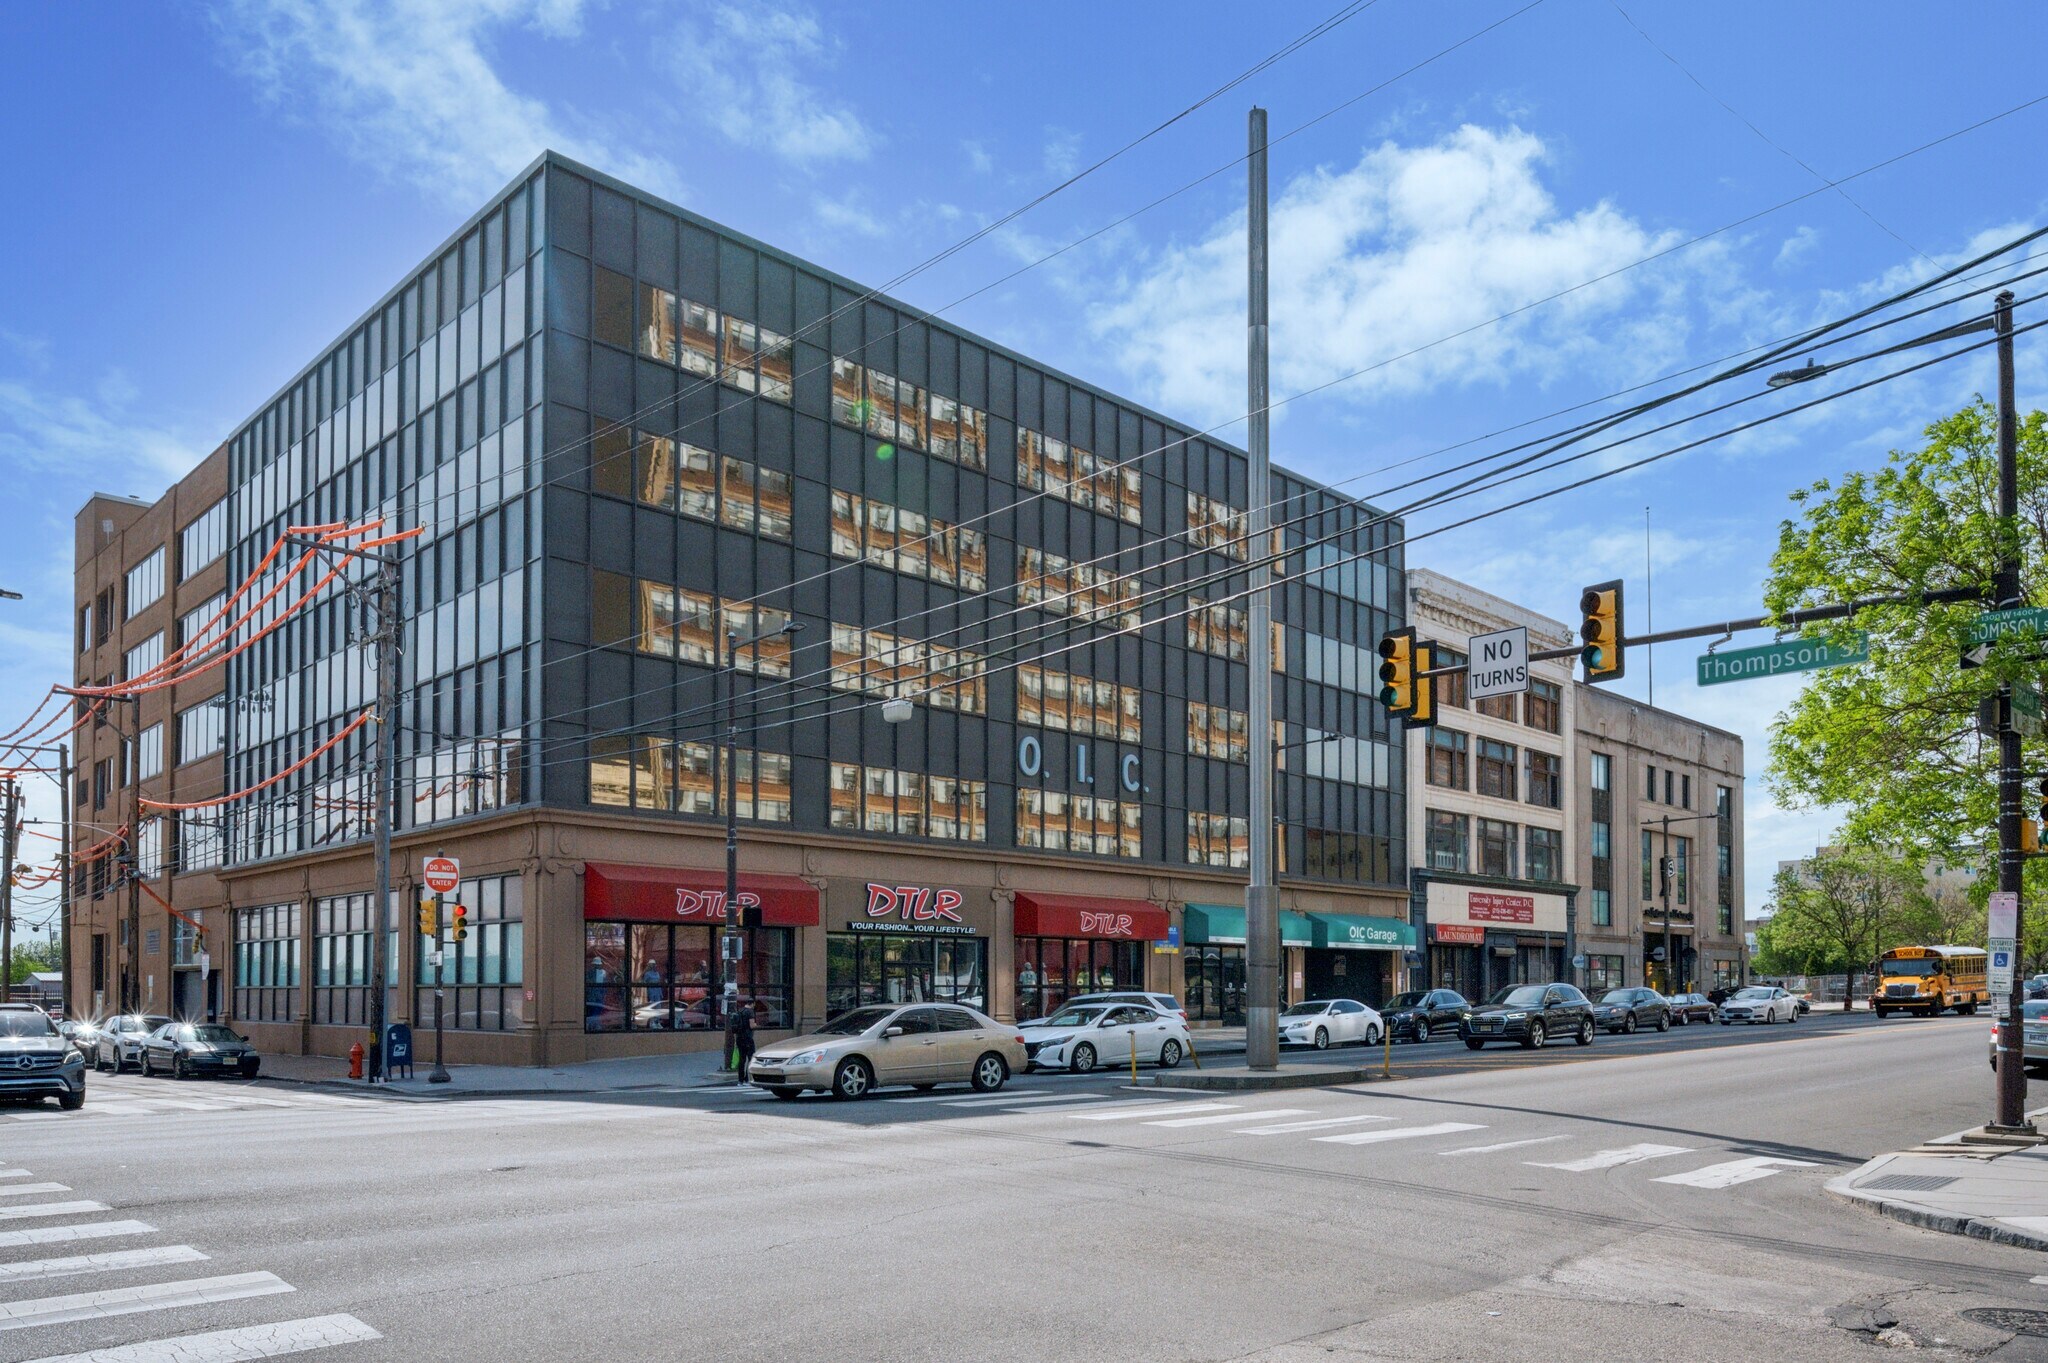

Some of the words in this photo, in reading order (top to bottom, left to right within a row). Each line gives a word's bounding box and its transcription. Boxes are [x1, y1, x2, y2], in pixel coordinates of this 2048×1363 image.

[2002, 611, 2012, 620] W
[2013, 608, 2034, 617] 1400
[1484, 639, 1512, 662] NO
[1701, 644, 1828, 679] Thompson
[1472, 666, 1525, 690] TURNS
[867, 883, 962, 922] DTLR
[851, 922, 873, 931] YOUR
[935, 926, 976, 934] LIFESTYLE!
[1080, 911, 1132, 935] DTLR
[1350, 926, 1365, 938] OIC
[1367, 927, 1396, 943] Garage
[1439, 931, 1483, 942] LAUNDROMAT
